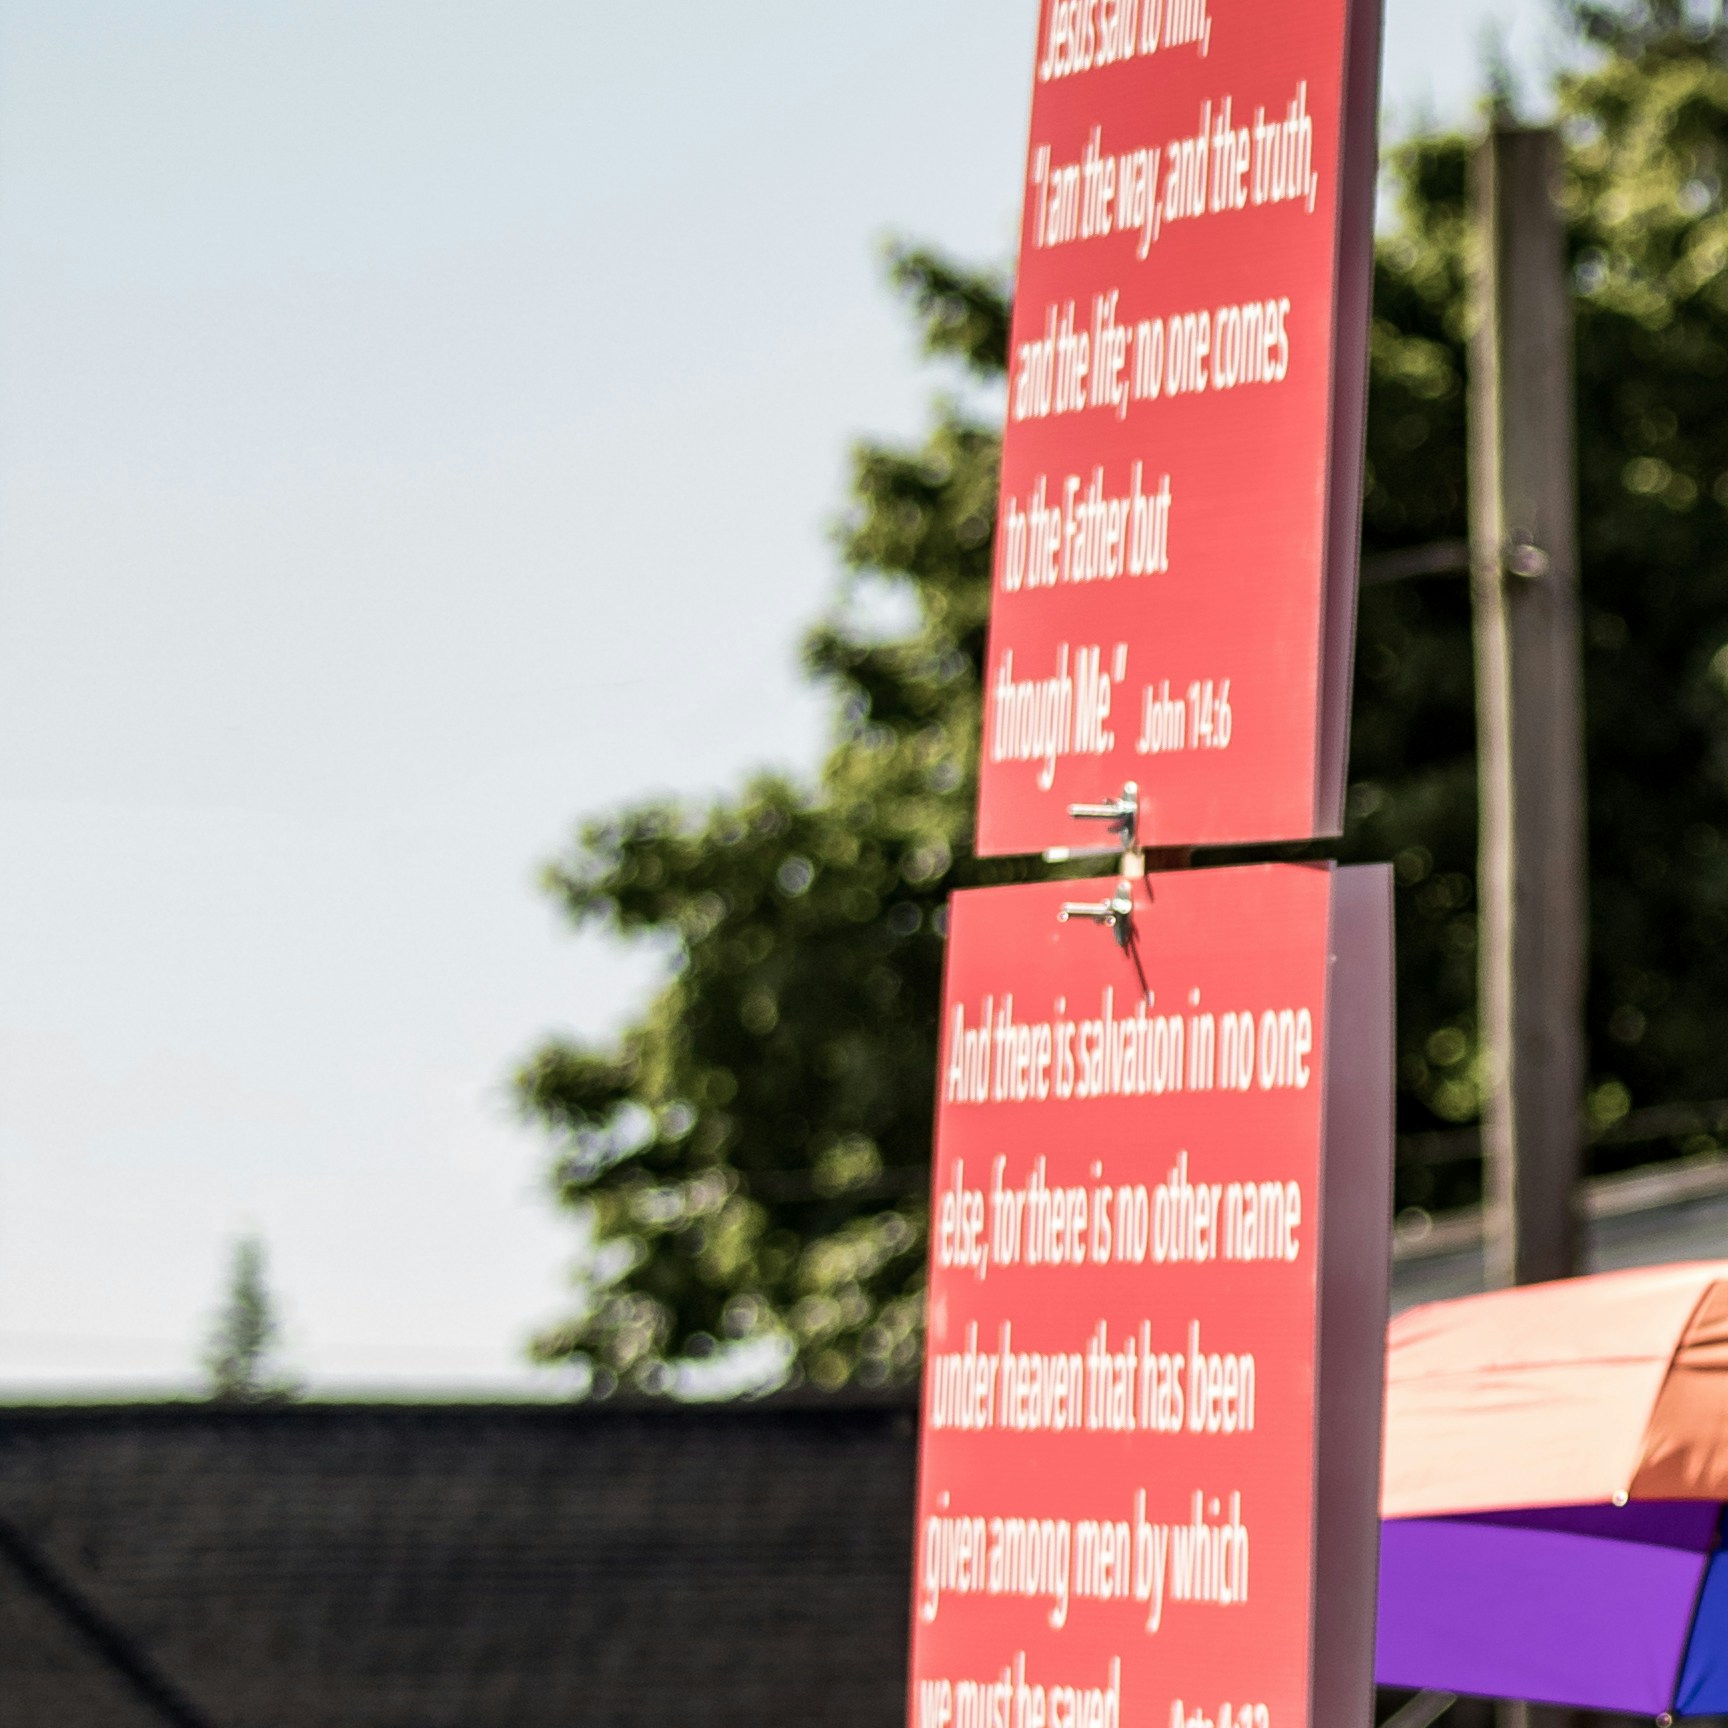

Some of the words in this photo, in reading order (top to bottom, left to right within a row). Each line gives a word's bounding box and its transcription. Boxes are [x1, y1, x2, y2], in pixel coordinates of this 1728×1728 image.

[1033, 144, 1052, 248] "I
[1047, 161, 1081, 247] am
[1080, 125, 1114, 240] the
[1114, 147, 1161, 260] way,
[1165, 100, 1209, 222] and
[1211, 95, 1250, 214] the
[1253, 80, 1318, 214] truth,
[1015, 304, 1057, 422] and
[1054, 300, 1089, 415] the
[1091, 289, 1132, 419] life;
[1134, 317, 1164, 400] no
[1166, 309, 1211, 397] one
[1213, 296, 1290, 390] comes
[1003, 496, 1028, 592] to
[1027, 475, 1062, 589] the
[1062, 466, 1131, 583] Father
[1131, 460, 1172, 576] but
[992, 643, 1071, 790] through
[1072, 643, 1128, 755] Me."
[1136, 679, 1186, 754] John
[1187, 678, 1233, 750] 14:6
[948, 995, 993, 1103] And
[994, 993, 1051, 1102] there
[1052, 996, 1076, 1099] is
[1078, 985, 1185, 1098] salvation
[1188, 987, 1216, 1091] in
[1220, 1010, 1255, 1092] no
[1260, 1007, 1313, 1090] one
[938, 1158, 988, 1280] else,
[991, 1155, 1025, 1266] for
[1027, 1155, 1087, 1266] there
[1090, 1160, 1113, 1265] is
[1116, 1184, 1149, 1264] no
[1153, 1150, 1222, 1264] other
[1225, 1180, 1302, 1262] name
[931, 1320, 998, 1430] under
[1000, 1321, 1084, 1431] heaven
[1087, 1320, 1138, 1432] that
[1140, 1319, 1185, 1433] has
[1188, 1319, 1256, 1434] been
[920, 1490, 985, 1624] given
[988, 1517, 1071, 1629] among
[1074, 1520, 1130, 1600] men
[1134, 1488, 1169, 1634] by
[1170, 1490, 1249, 1606] which
